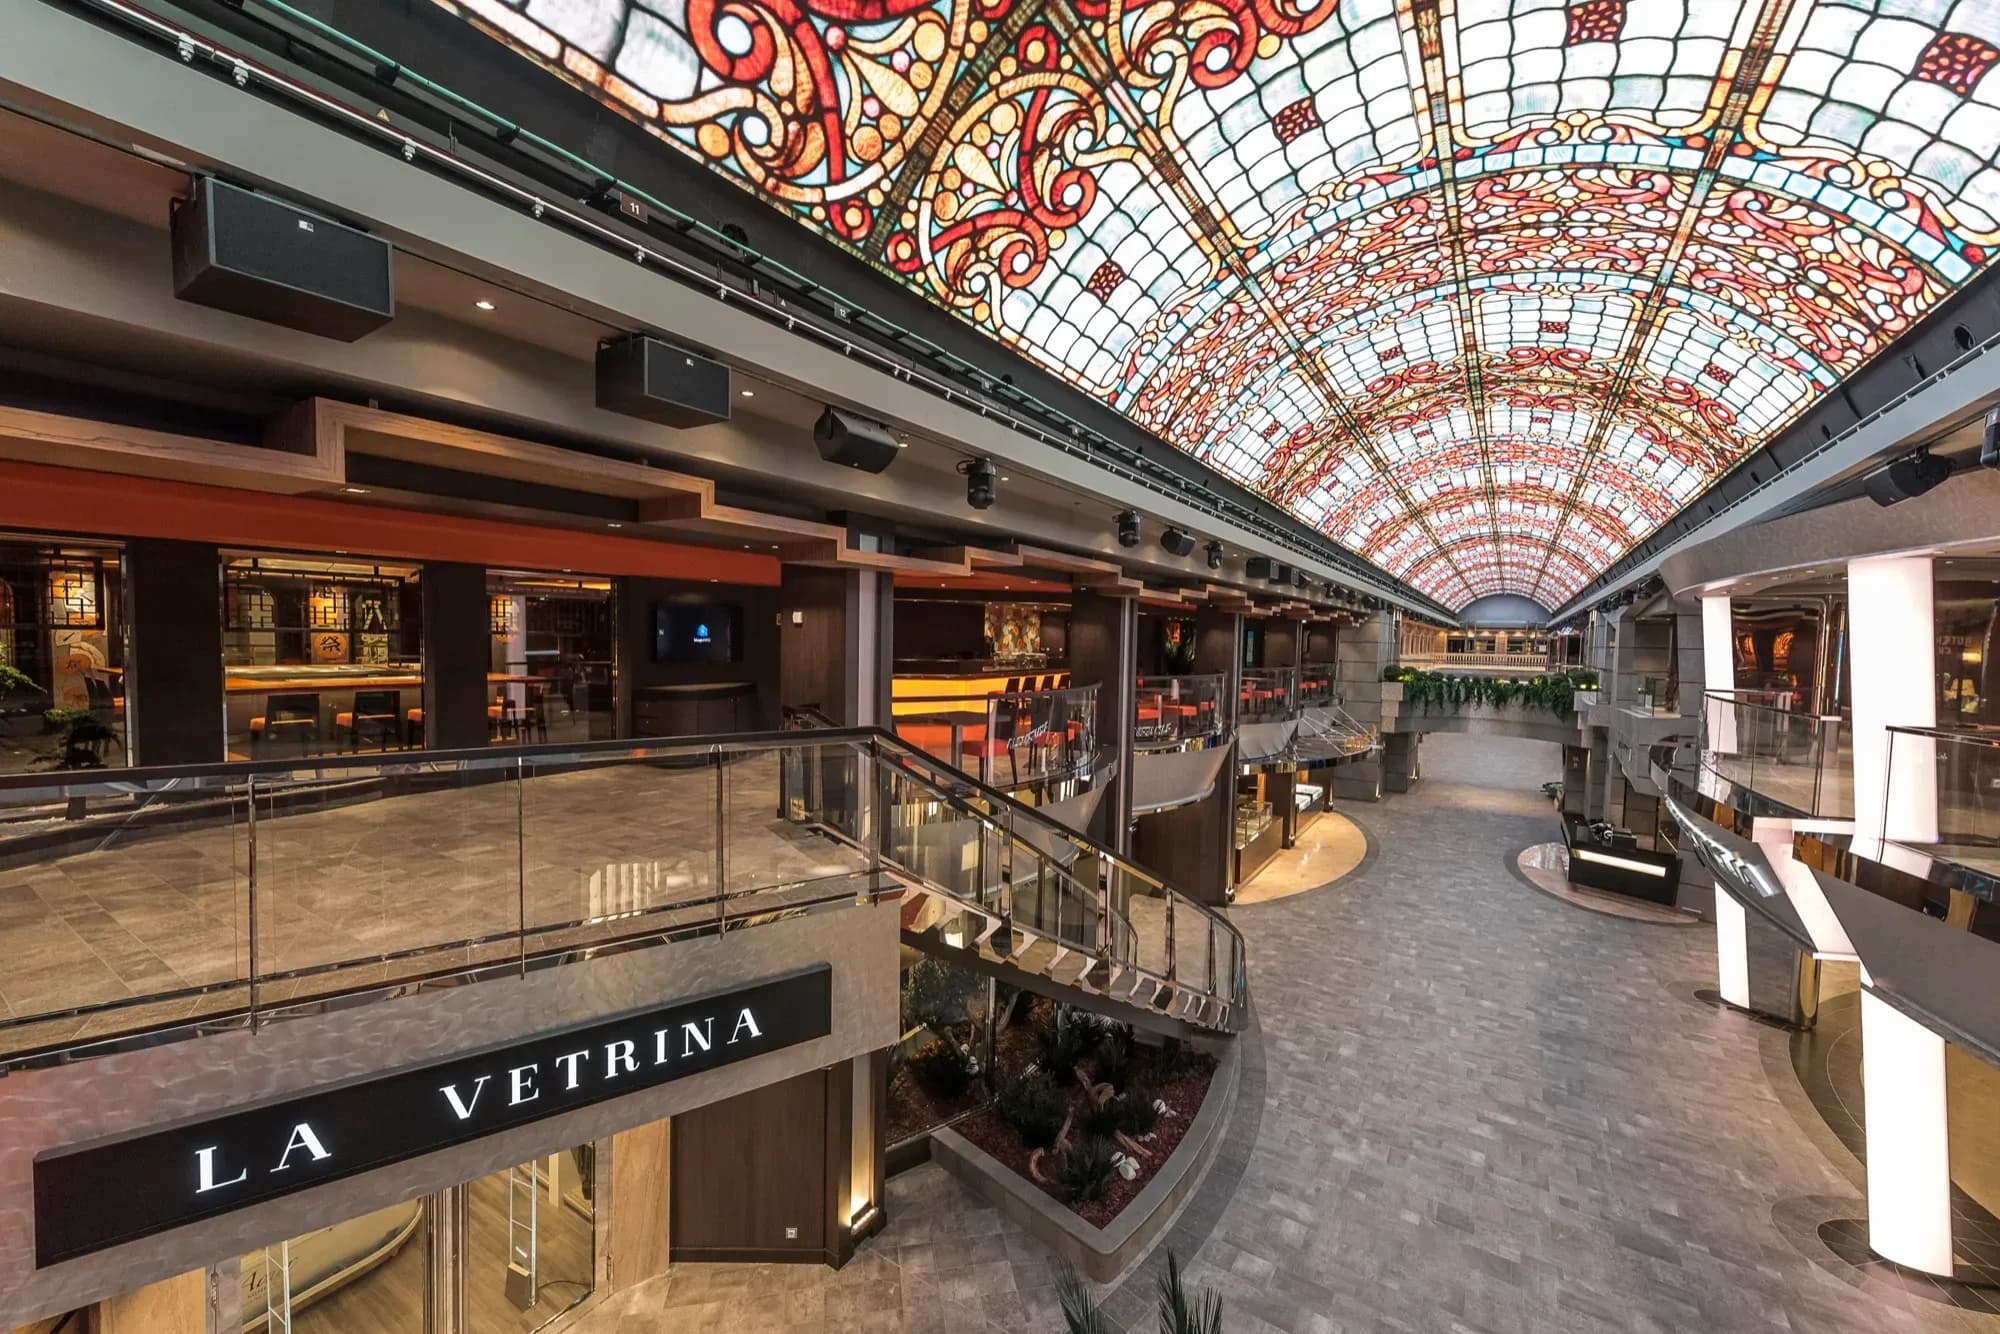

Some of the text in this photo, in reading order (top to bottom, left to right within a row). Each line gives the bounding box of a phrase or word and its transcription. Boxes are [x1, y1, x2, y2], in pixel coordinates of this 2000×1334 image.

[629, 202, 640, 215] 11
[839, 308, 847, 319] 12
[195, 1008, 762, 1193] LA VETRINA
